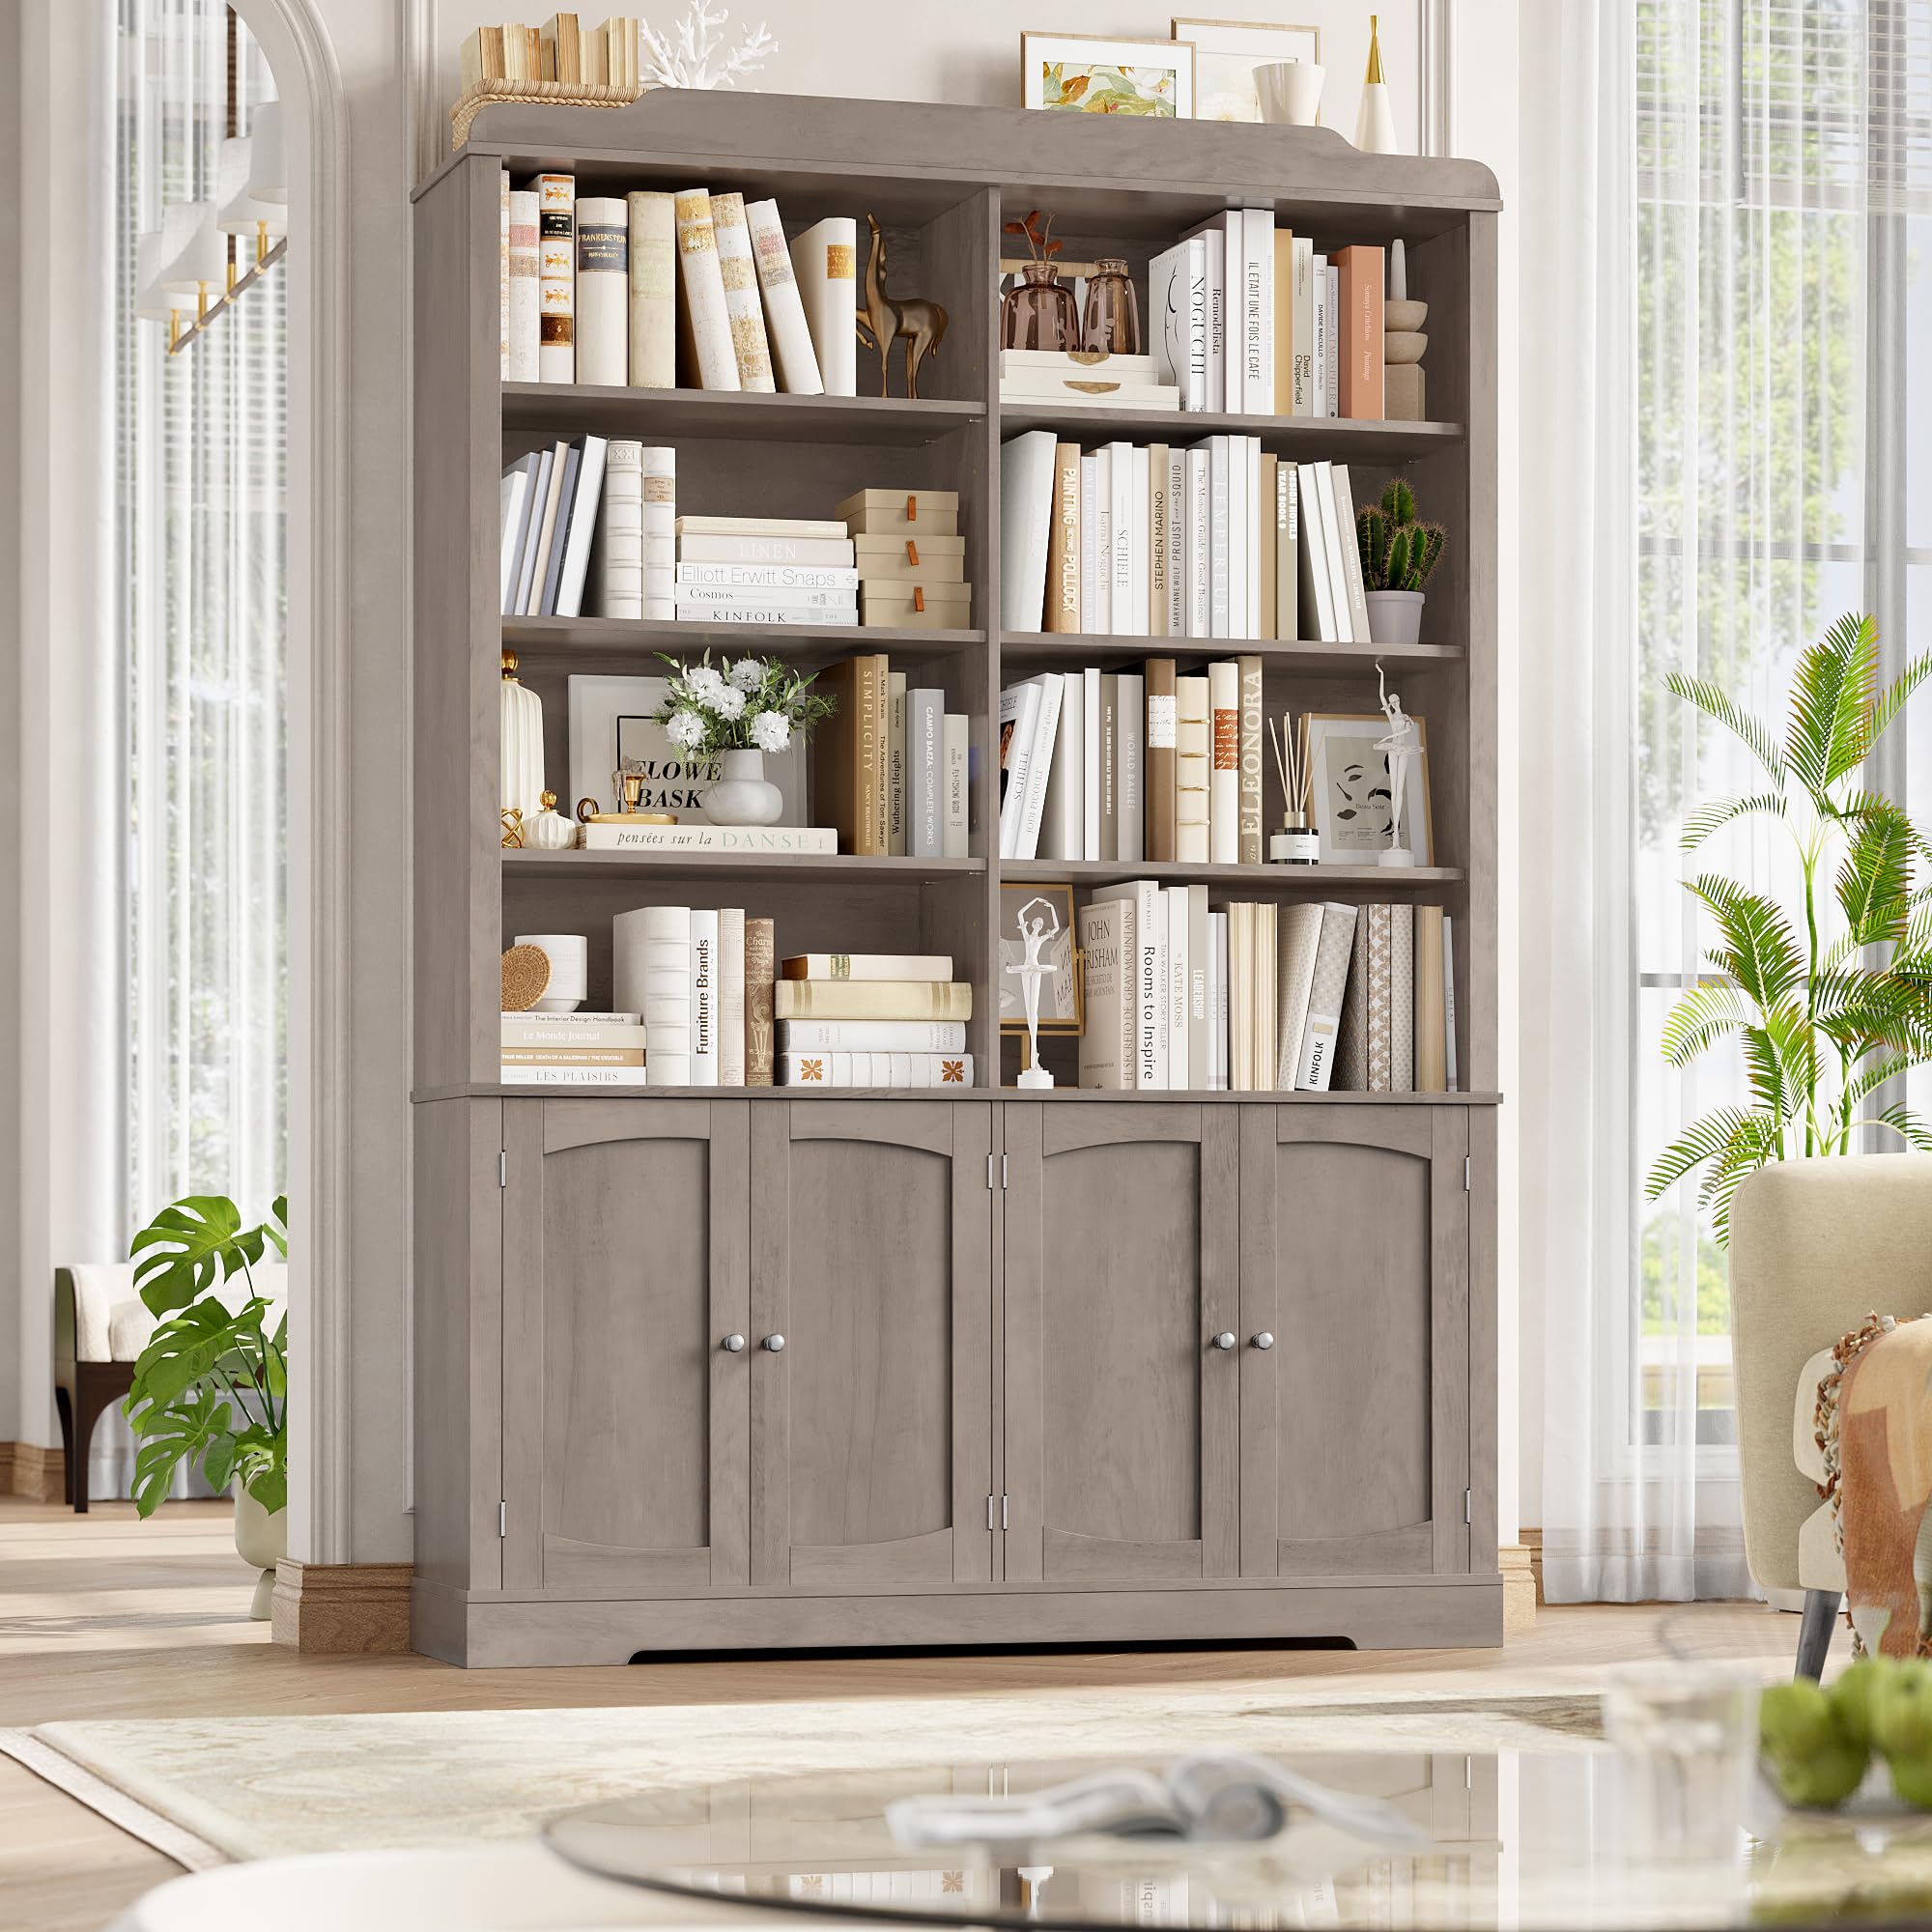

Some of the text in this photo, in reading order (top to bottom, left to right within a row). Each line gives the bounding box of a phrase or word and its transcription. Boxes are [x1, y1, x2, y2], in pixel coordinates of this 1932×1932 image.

[1248, 262, 1260, 270] IL
[1191, 275, 1205, 375] NOGUCHI
[1212, 288, 1222, 355] Remodelista
[1248, 300, 1260, 319] UNE
[1248, 321, 1260, 341] FOIS
[1248, 343, 1260, 355] LE
[1294, 355, 1303, 405] Chipperfield
[1328, 330, 1337, 409] ATMOSPHERE
[1063, 468, 1077, 526] PAINTING
[1172, 464, 1181, 497] SQUID
[1278, 469, 1287, 494] YEAR
[1278, 496, 1287, 522] BOOK
[1289, 469, 1297, 540] DESIGN HOTELS
[739, 542, 797, 560] LINEN
[1117, 529, 1128, 588] SCHIELE
[1154, 491, 1164, 590] STEPHEN MARINO
[1172, 521, 1181, 561] PROUST
[1198, 552, 1205, 561] to
[682, 565, 836, 588] Elliott Erwitt Snaps
[690, 587, 734, 600] Cosmos
[1063, 554, 1076, 613] POLLOCK
[713, 610, 787, 623] KINFOLK
[863, 670, 873, 772] SIMPLICITY
[925, 706, 934, 739] CAMPO
[636, 760, 723, 781] FLOWE
[892, 750, 902, 784] Heights
[1126, 732, 1136, 810] WORLD BALLET
[1241, 669, 1263, 836] ELEONORA
[925, 770, 934, 814] COMPLETE
[1014, 750, 1030, 801] SCHIELE
[637, 788, 704, 809] BASK
[880, 793, 886, 802] of
[892, 787, 902, 835] Wuthering
[617, 832, 666, 846] pensées
[698, 832, 712, 845] la
[722, 832, 810, 849] DANSE
[925, 815, 934, 845] WORKS
[1087, 919, 1110, 946] JOHN
[696, 939, 709, 1055] Furniture Brands
[1123, 911, 1133, 1081] EL SECRETO DE GRAY MOUNTAIN
[1174, 962, 1183, 1028] KATE MOSS
[1193, 969, 1205, 1020] LEADERSHIP
[1140, 947, 1156, 1080] Rooms to Inspire
[536, 1031, 567, 1040] Monde
[568, 1031, 601, 1041] Journal
[536, 1071, 557, 1081] LES
[563, 1071, 618, 1081] PLAISIRS
[1308, 1041, 1324, 1085] KINFOLK
